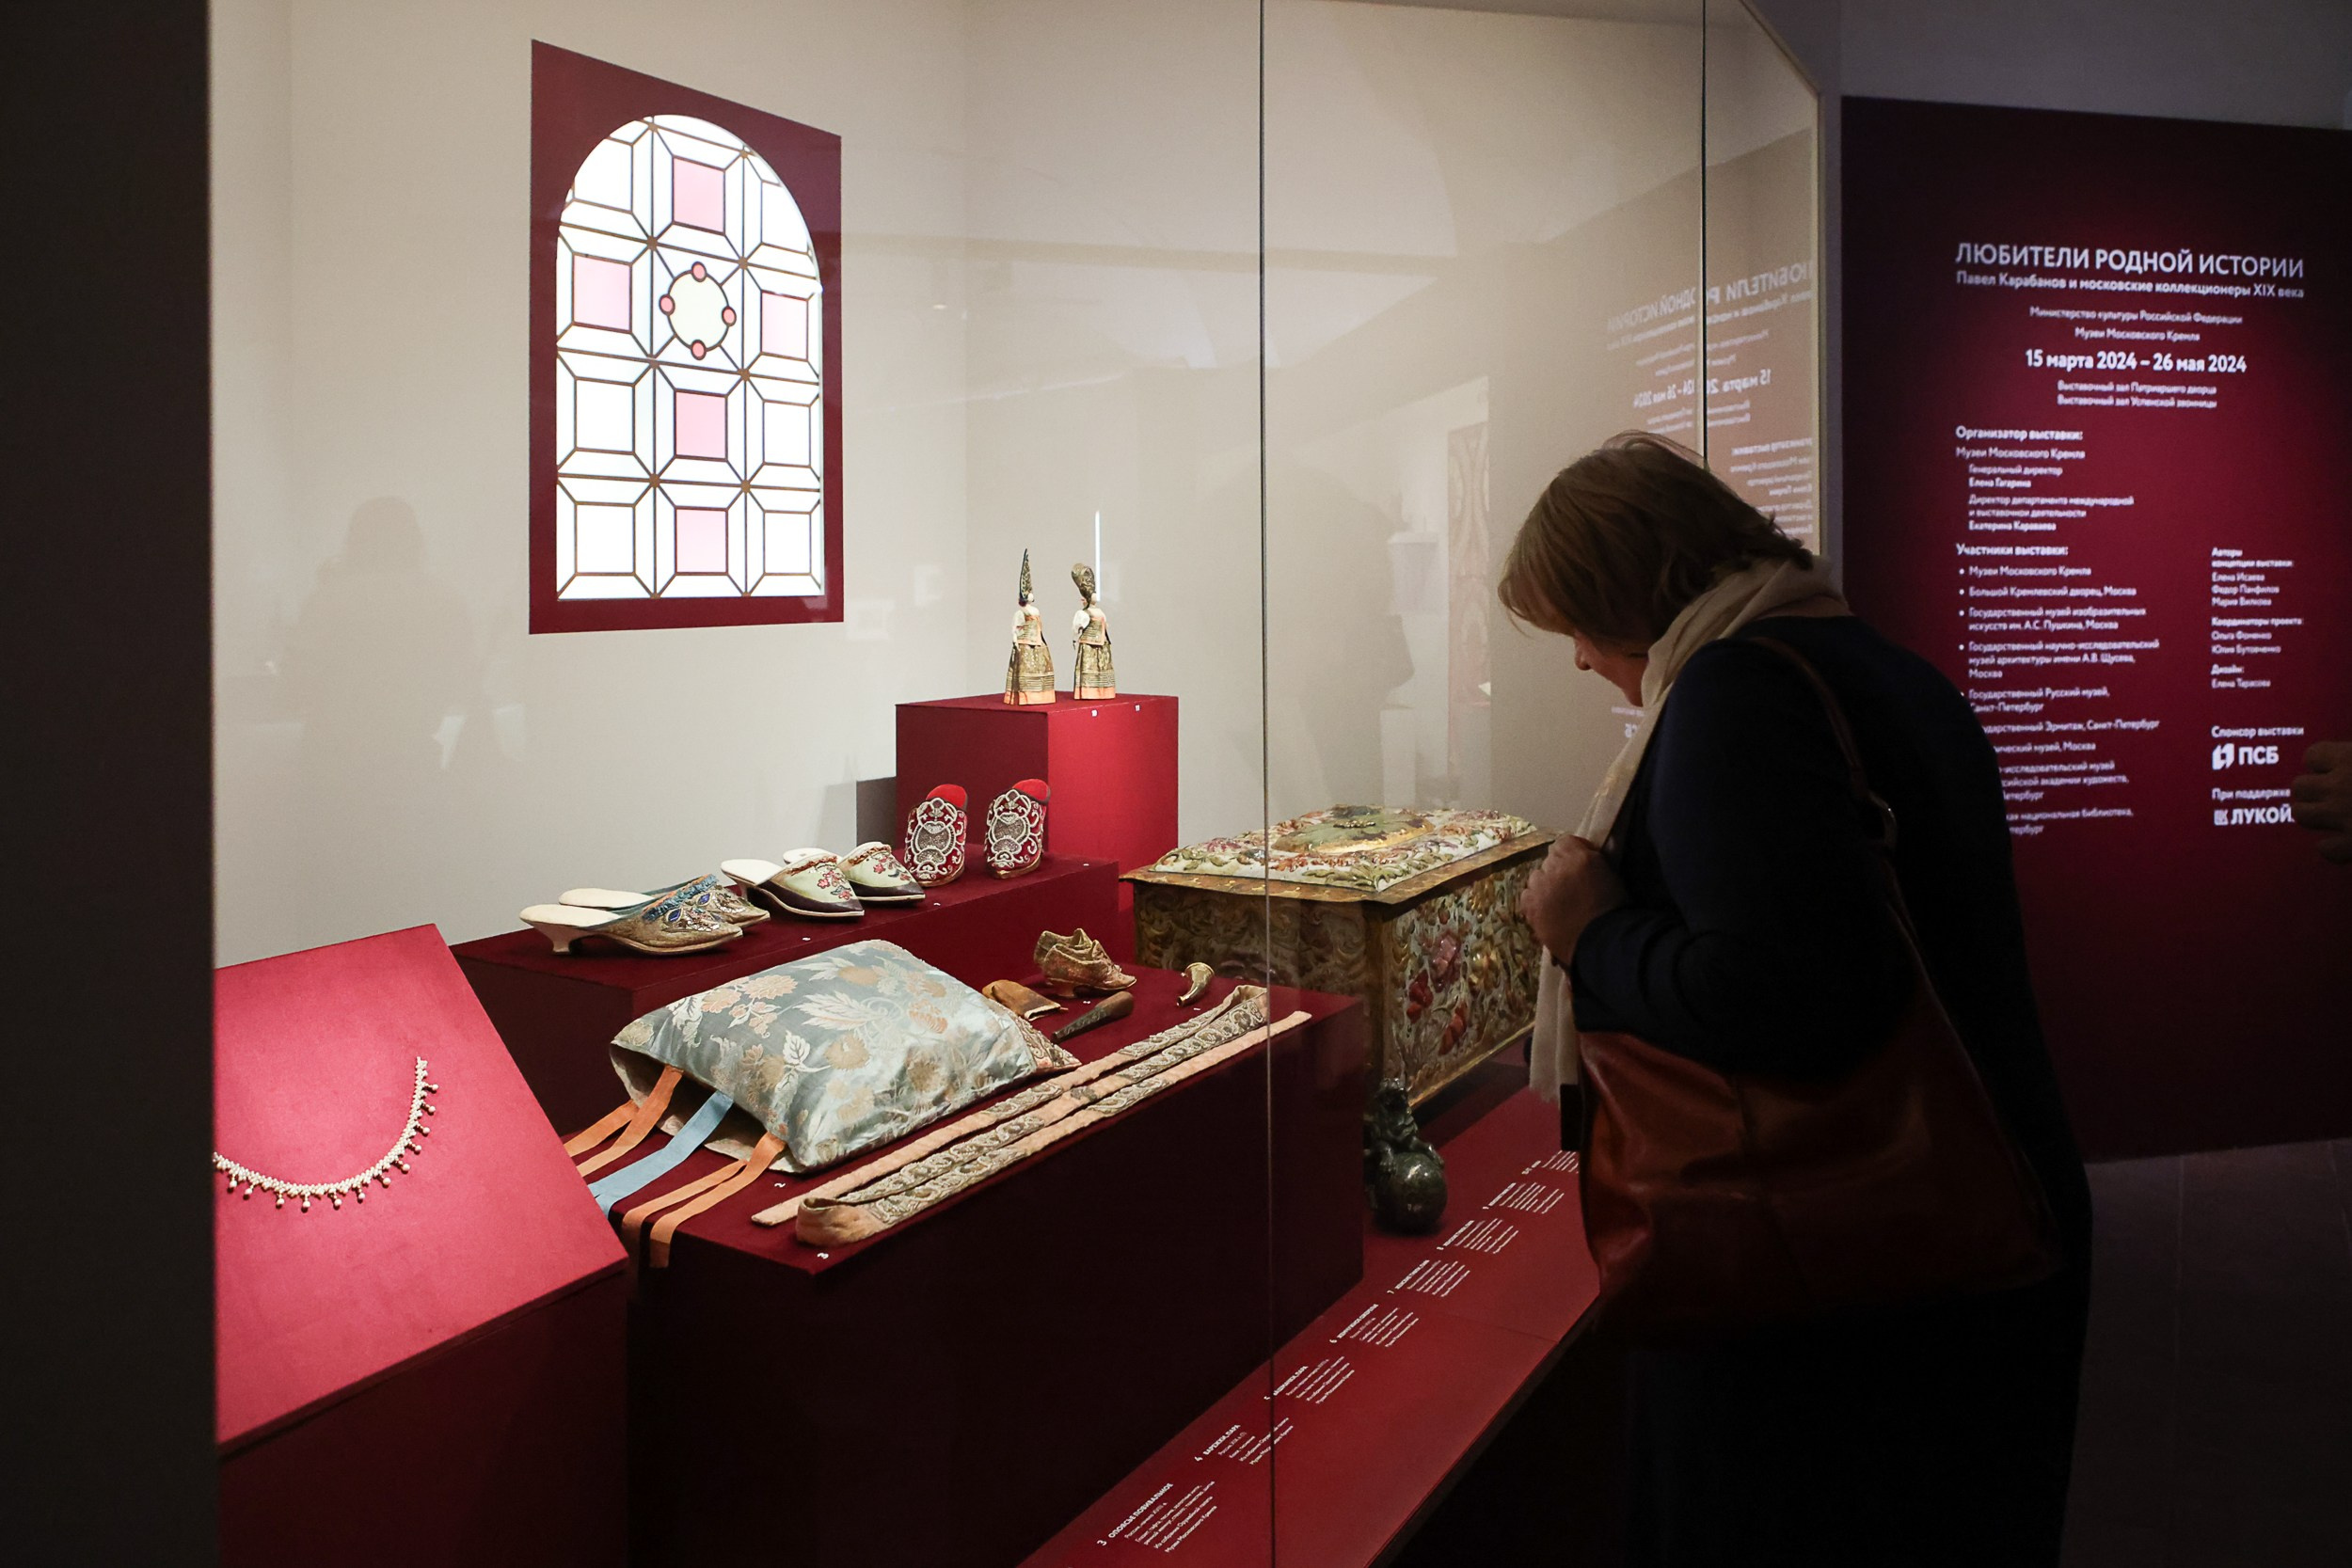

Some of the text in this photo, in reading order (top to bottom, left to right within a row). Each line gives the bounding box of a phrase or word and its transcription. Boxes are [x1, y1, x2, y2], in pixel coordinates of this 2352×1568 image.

[1956, 243, 2303, 278] ЛЮБИТЕЛИ РОДНОЙ ИСТОРИИ
[1957, 271, 2304, 297] Павел Карабанов и московские коллекционеры XIX века
[2030, 306, 2243, 325] Министерство культуры Российской Федерации
[2074, 327, 2200, 342] Музеи Московского Кремля
[2026, 349, 2042, 367] 15
[2047, 355, 2093, 372] марта
[2097, 351, 2137, 370] 2024
[2153, 353, 2173, 371] 26
[2176, 359, 2204, 372] мая
[2208, 355, 2247, 372] 2024
[2058, 380, 2114, 391] Выставочный
[2131, 382, 2185, 395] Патриаршего
[2186, 386, 2217, 395] дворца
[2058, 395, 2114, 406] Выставочный
[2131, 397, 2175, 408] Успенской
[1956, 425, 2083, 442] Организатор выставки:
[1956, 447, 2085, 460] Музеи Московского Кремля
[1969, 464, 2063, 477] Генеральный директор
[1969, 477, 2031, 488] Елена Гагарина
[1969, 494, 2135, 507] Директор департамента международной
[1969, 520, 2012, 531] Екатерина
[1956, 544, 2068, 556] Участники выставки:
[2212, 547, 2243, 558] Авторы
[1969, 566, 2091, 578] Музеи Московского Кремля
[2211, 572, 2235, 582] Елена
[1969, 587, 2009, 597] Большой
[2010, 586, 2068, 598] Кремлевский
[2104, 586, 2137, 596] Москва
[1969, 607, 2146, 619] Государственный музей изобразительных
[1969, 621, 2007, 633] искусств
[2086, 620, 2119, 630] Москва
[1969, 641, 2043, 654] Государственный
[1969, 657, 1995, 666] музей
[1997, 655, 2051, 666] архитектуры
[2053, 656, 2080, 664] имени
[1969, 669, 2003, 679] Москва
[2211, 678, 2235, 689] Елена
[1969, 689, 2043, 702] Государственный
[2045, 688, 2080, 700] Русский
[2087, 719, 2159, 731] Санкт-Петербург
[2212, 726, 2304, 738] Спонсор выставки
[2063, 741, 2096, 752] Москва
[2238, 746, 2279, 765] ПСБ
[2090, 760, 2115, 772] музей
[2212, 788, 2290, 801] При поддержке
[2231, 803, 2295, 825] ЛУКОЙ
